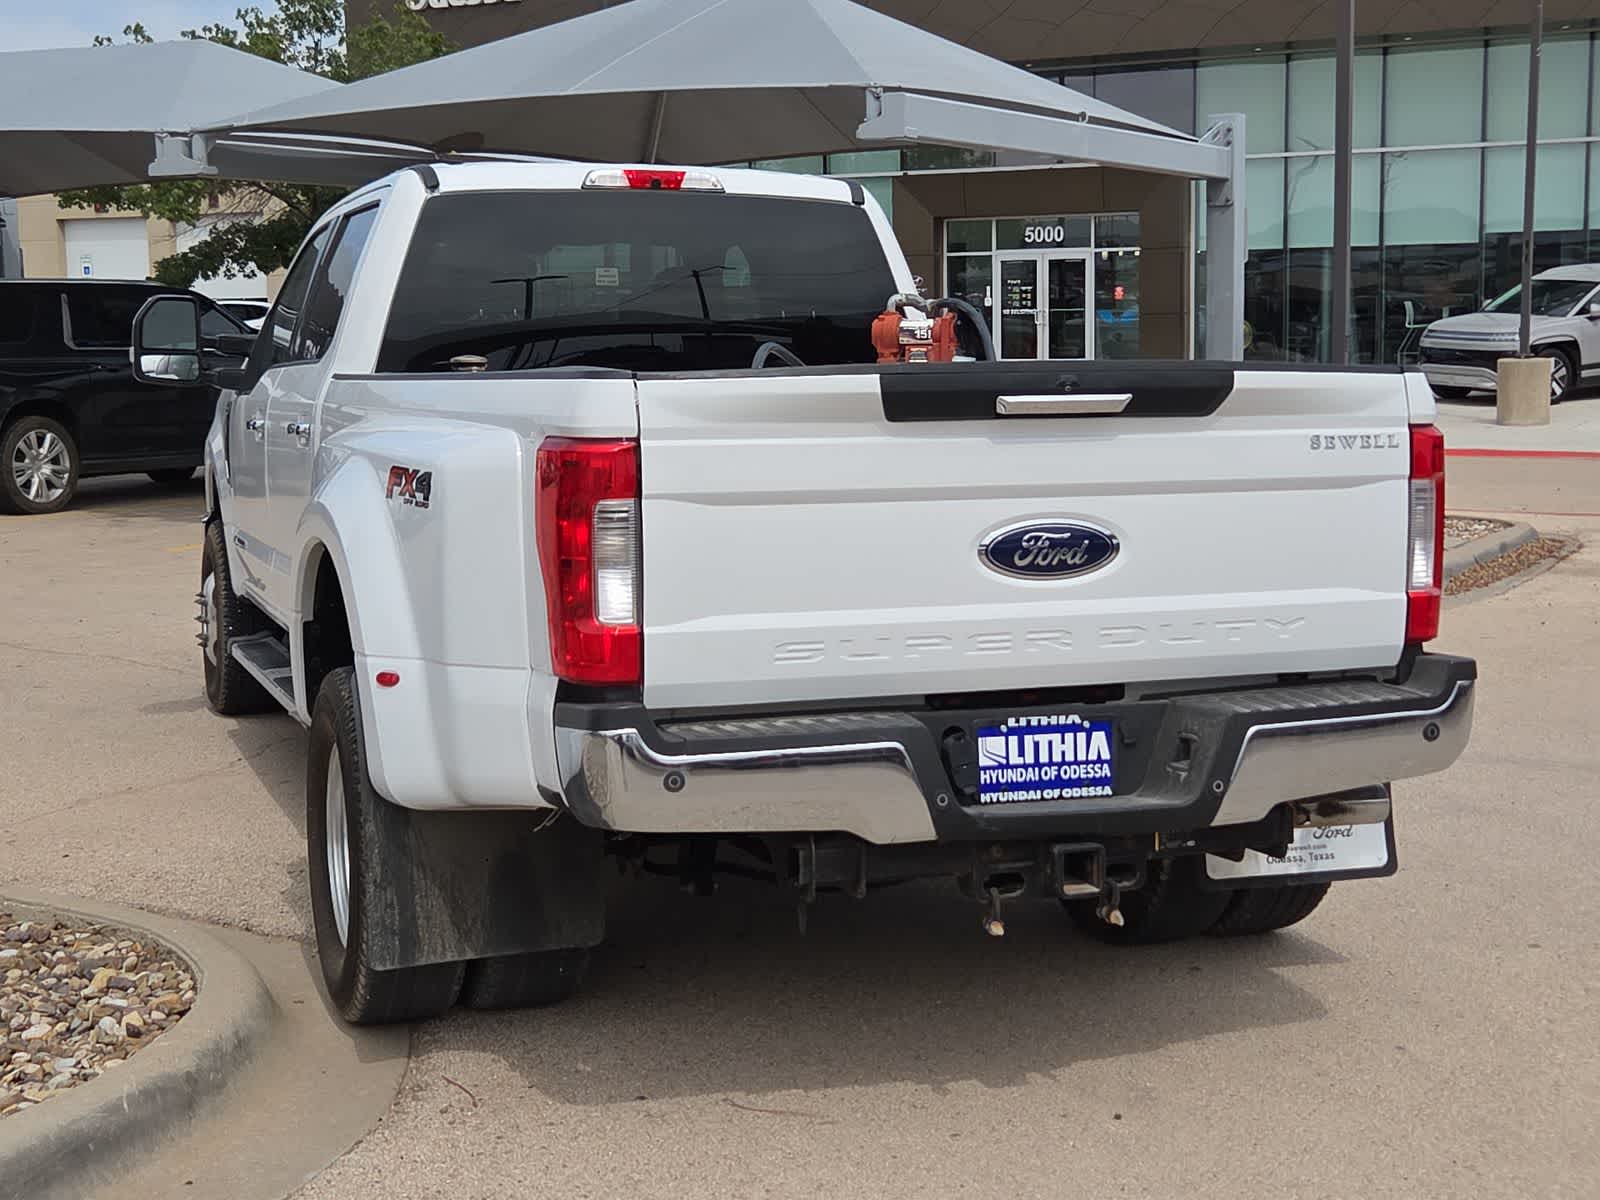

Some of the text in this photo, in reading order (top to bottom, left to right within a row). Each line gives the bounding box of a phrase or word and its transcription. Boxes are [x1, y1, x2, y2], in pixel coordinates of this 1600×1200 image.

[1024, 226, 1064, 242] 5000
[1310, 434, 1400, 450] SEWELL
[385, 465, 432, 501] FX4
[1013, 532, 1089, 567] Ford
[773, 616, 1305, 665] SUPER DUTY
[1007, 714, 1082, 727] LITHIA
[1008, 731, 1111, 765] LITHIA
[980, 763, 1111, 785] HYUNDAI OF ODESSA
[980, 785, 1113, 804] HYUNDAI OF ODESSA
[1309, 851, 1335, 862] Texas
